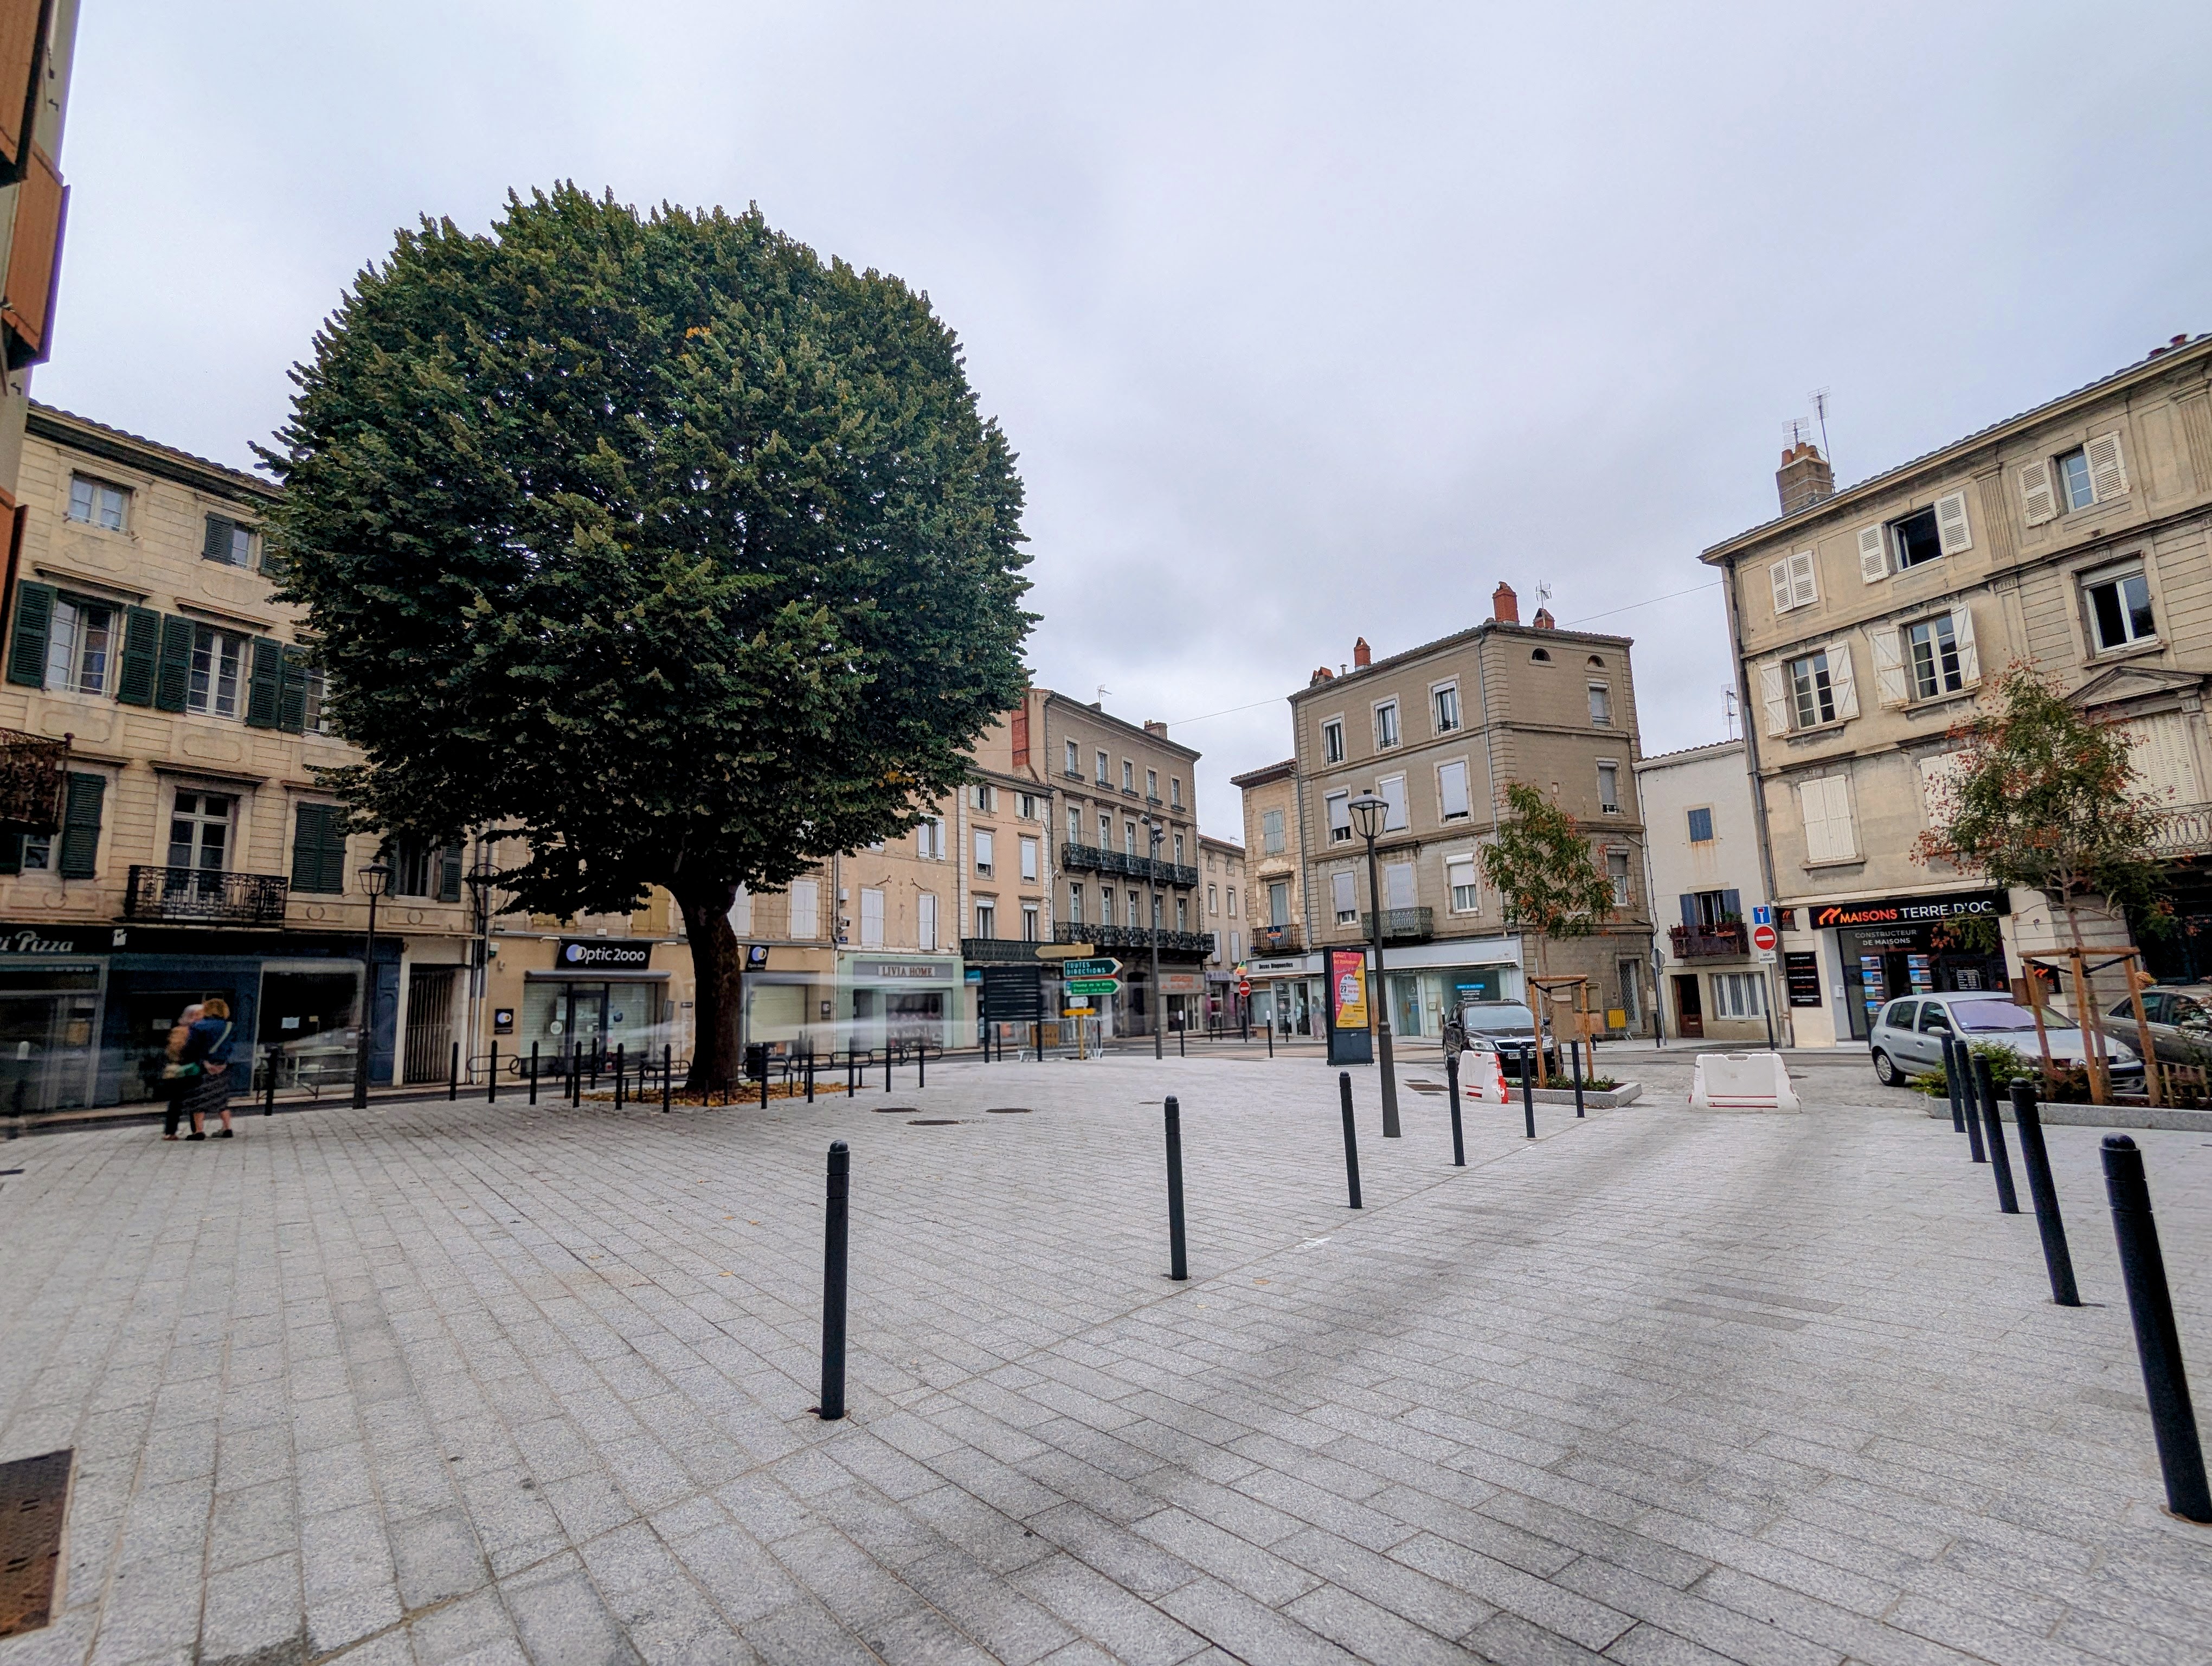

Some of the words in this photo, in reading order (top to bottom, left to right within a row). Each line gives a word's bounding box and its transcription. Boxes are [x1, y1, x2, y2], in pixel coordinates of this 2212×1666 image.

[1840, 909, 1898, 923] MAISONS
[1900, 904, 1949, 918] TERRE
[1954, 901, 1992, 914] D'OC
[15, 930, 74, 952] Pizza
[1855, 930, 1917, 939] CONSTRUCTEUR
[576, 946, 613, 964] Optic
[613, 948, 646, 962] 2000
[882, 966, 906, 976] LIVIA
[910, 967, 933, 976] HOME
[1340, 985, 1347, 994] 27
